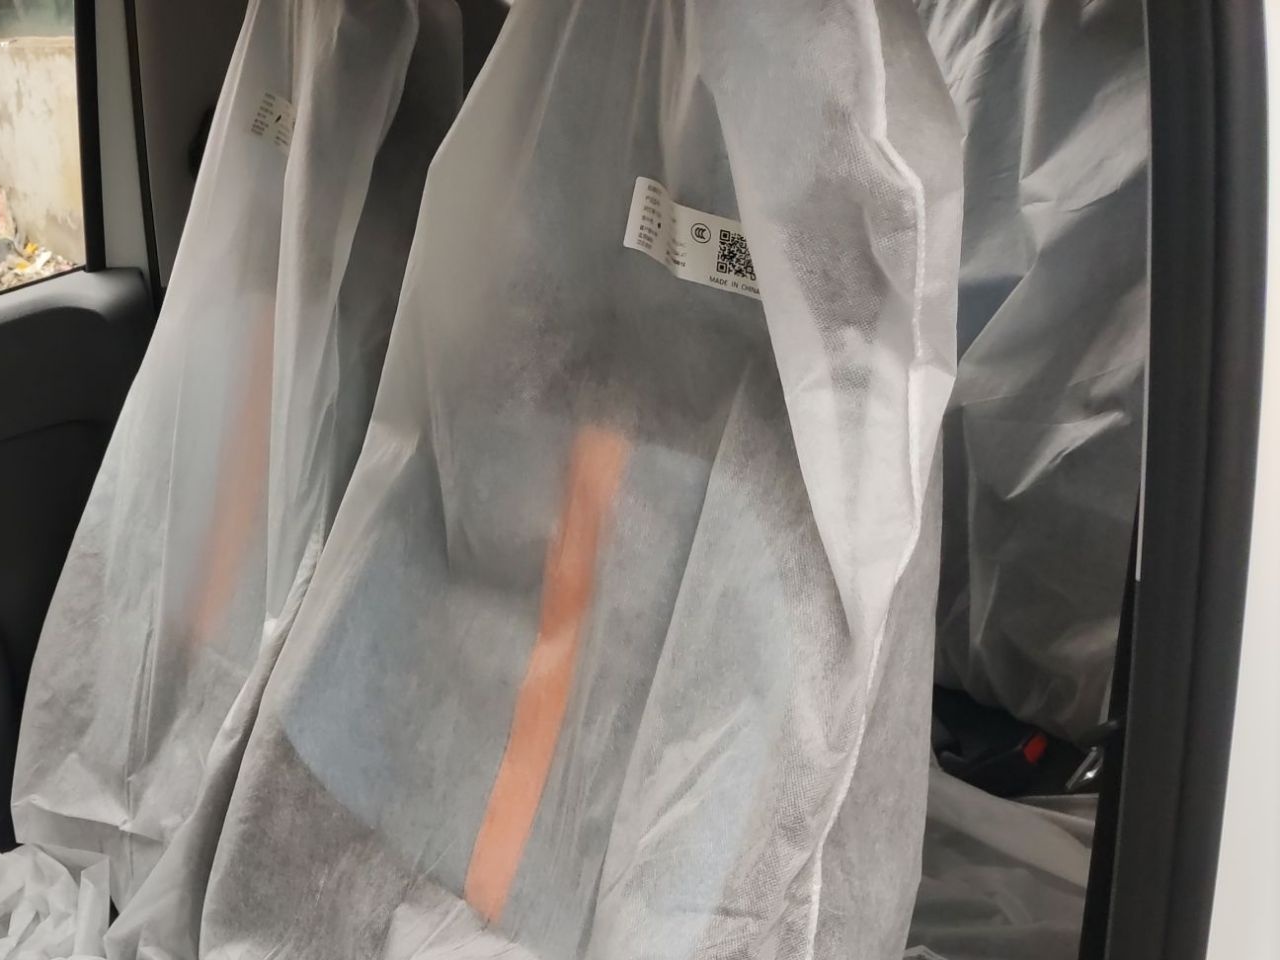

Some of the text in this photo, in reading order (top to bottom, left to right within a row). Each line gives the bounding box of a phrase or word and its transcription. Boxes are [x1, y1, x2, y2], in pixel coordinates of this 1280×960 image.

[709, 275, 760, 294] MADE IN CHINA
